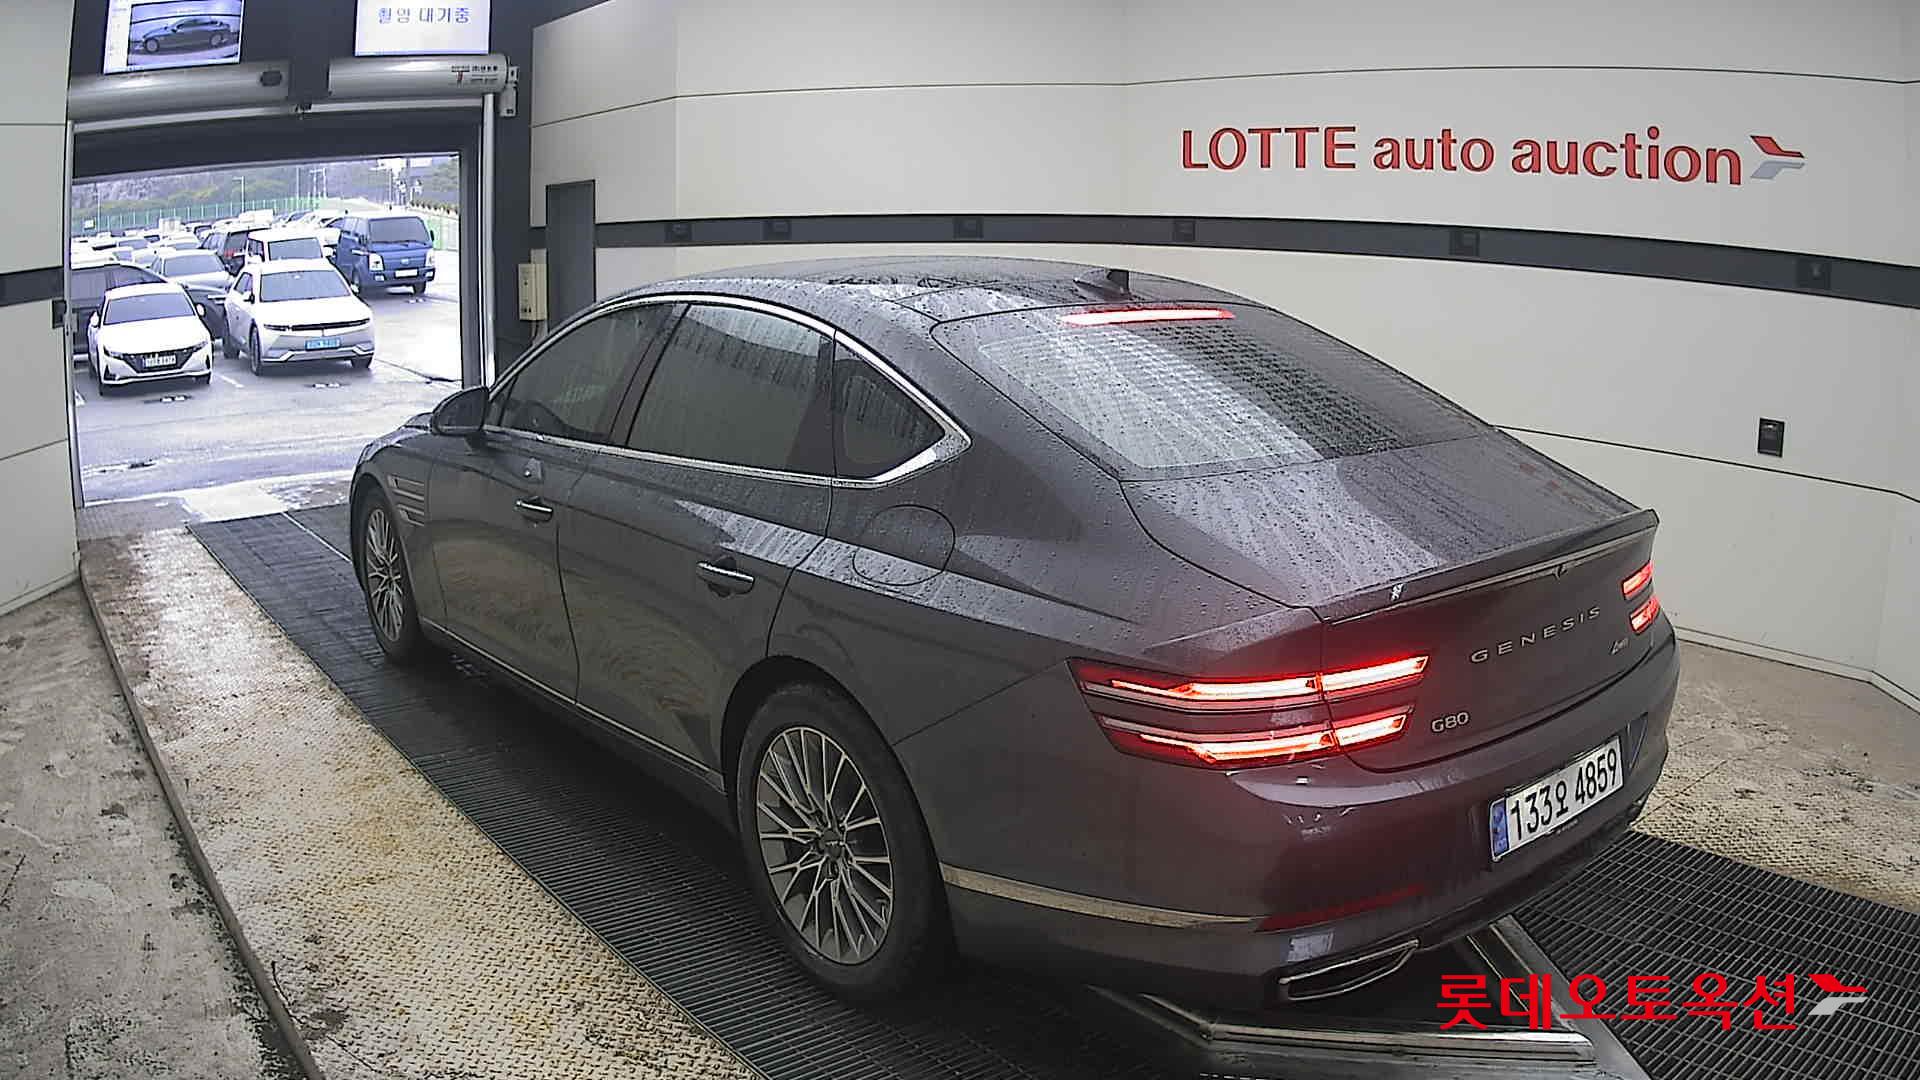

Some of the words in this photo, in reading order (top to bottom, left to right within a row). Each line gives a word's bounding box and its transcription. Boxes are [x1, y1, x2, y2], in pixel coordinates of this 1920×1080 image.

[418, 7, 471, 24] 대기중
[1181, 126, 1357, 171] LOTTE
[1372, 128, 1495, 172] auto
[1510, 125, 1743, 186] auction
[1469, 605, 1602, 664] GENESIS
[1431, 710, 1471, 733] G80
[1510, 780, 1569, 841] 133오
[1574, 747, 1618, 805] 4859
